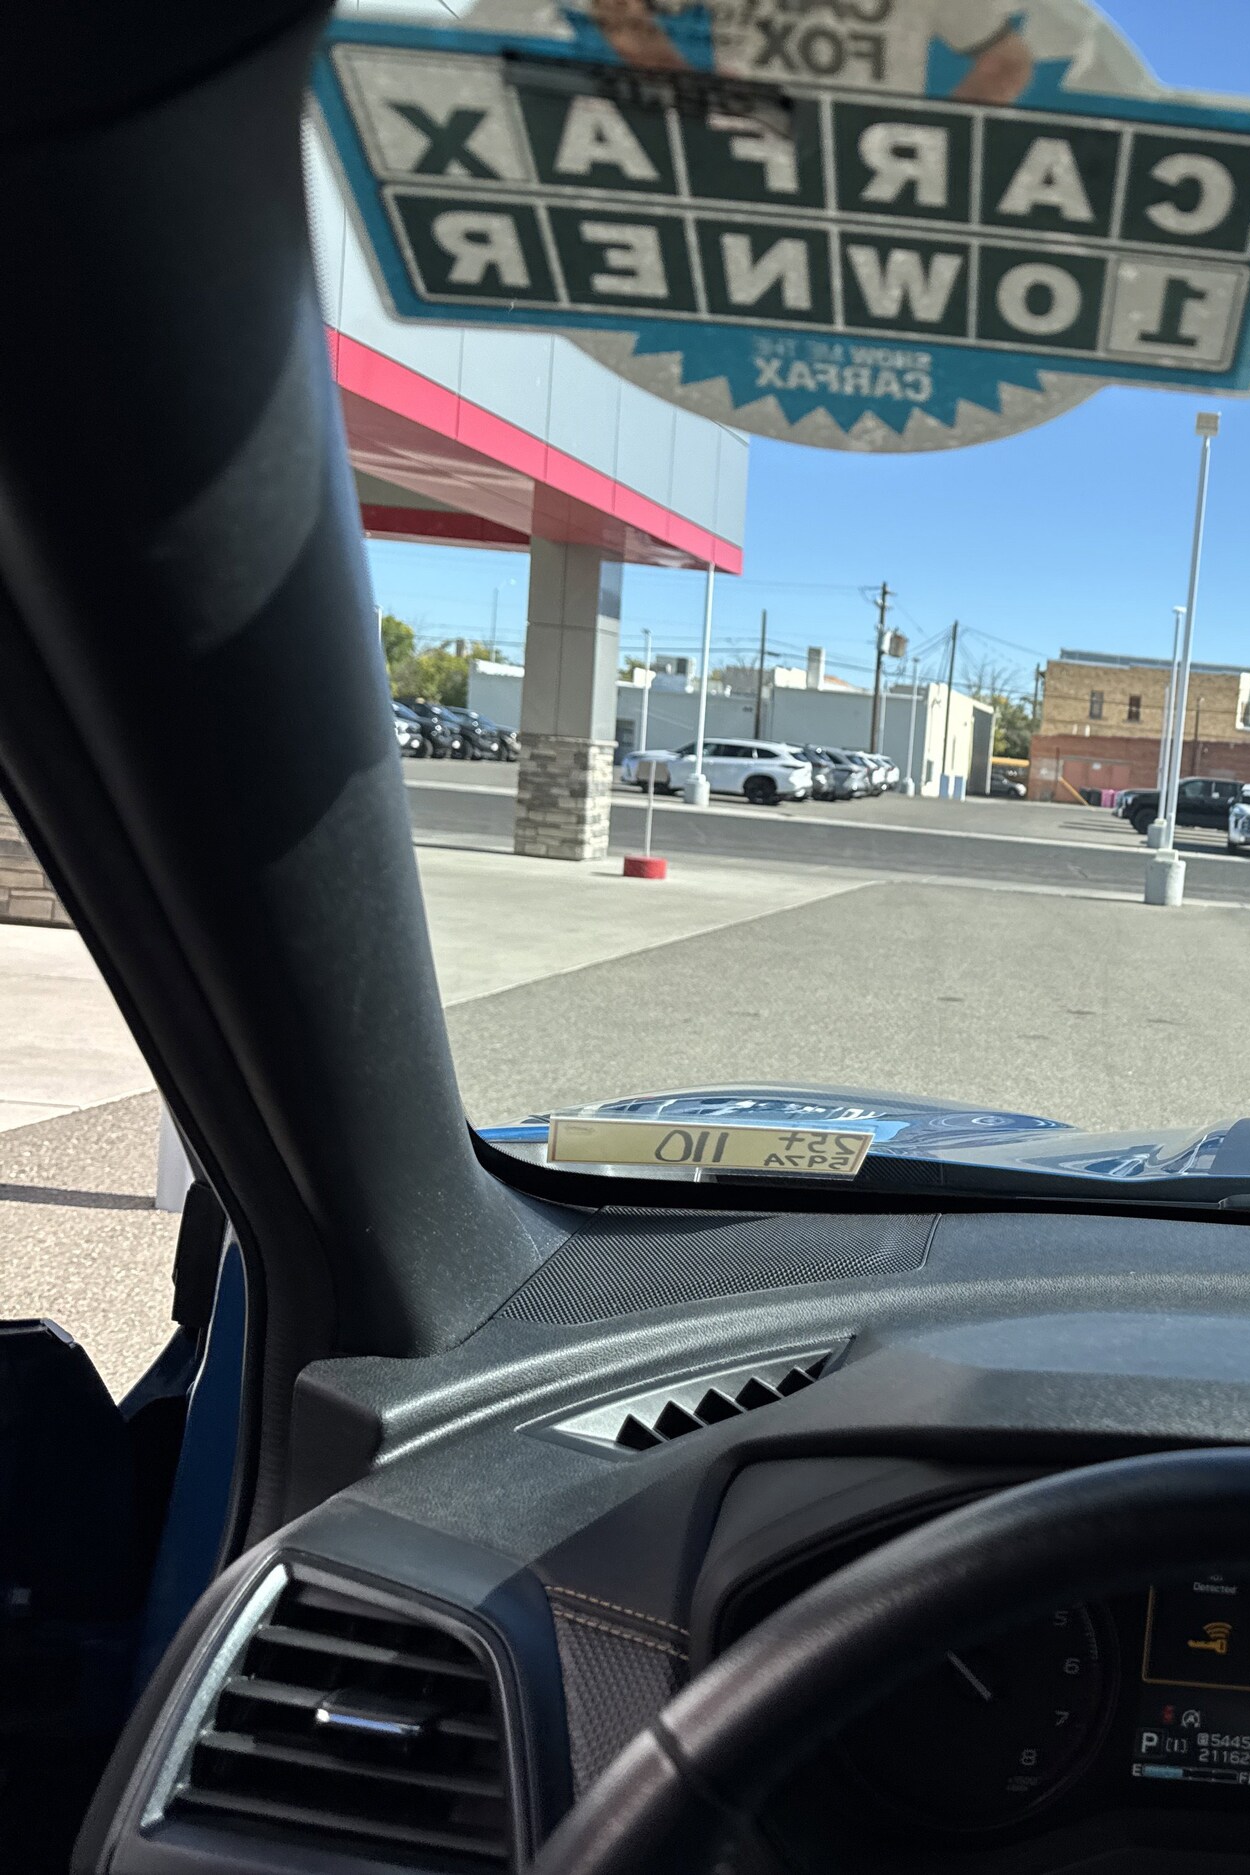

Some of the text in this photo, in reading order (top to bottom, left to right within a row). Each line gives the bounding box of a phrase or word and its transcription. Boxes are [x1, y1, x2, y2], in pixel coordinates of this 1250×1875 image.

[1063, 1657, 1080, 1675] 6
[1055, 1710, 1070, 1727] 7
[1141, 1732, 1159, 1754] P
[1020, 1747, 1038, 1767] 8
[1132, 1763, 1143, 1777] E
